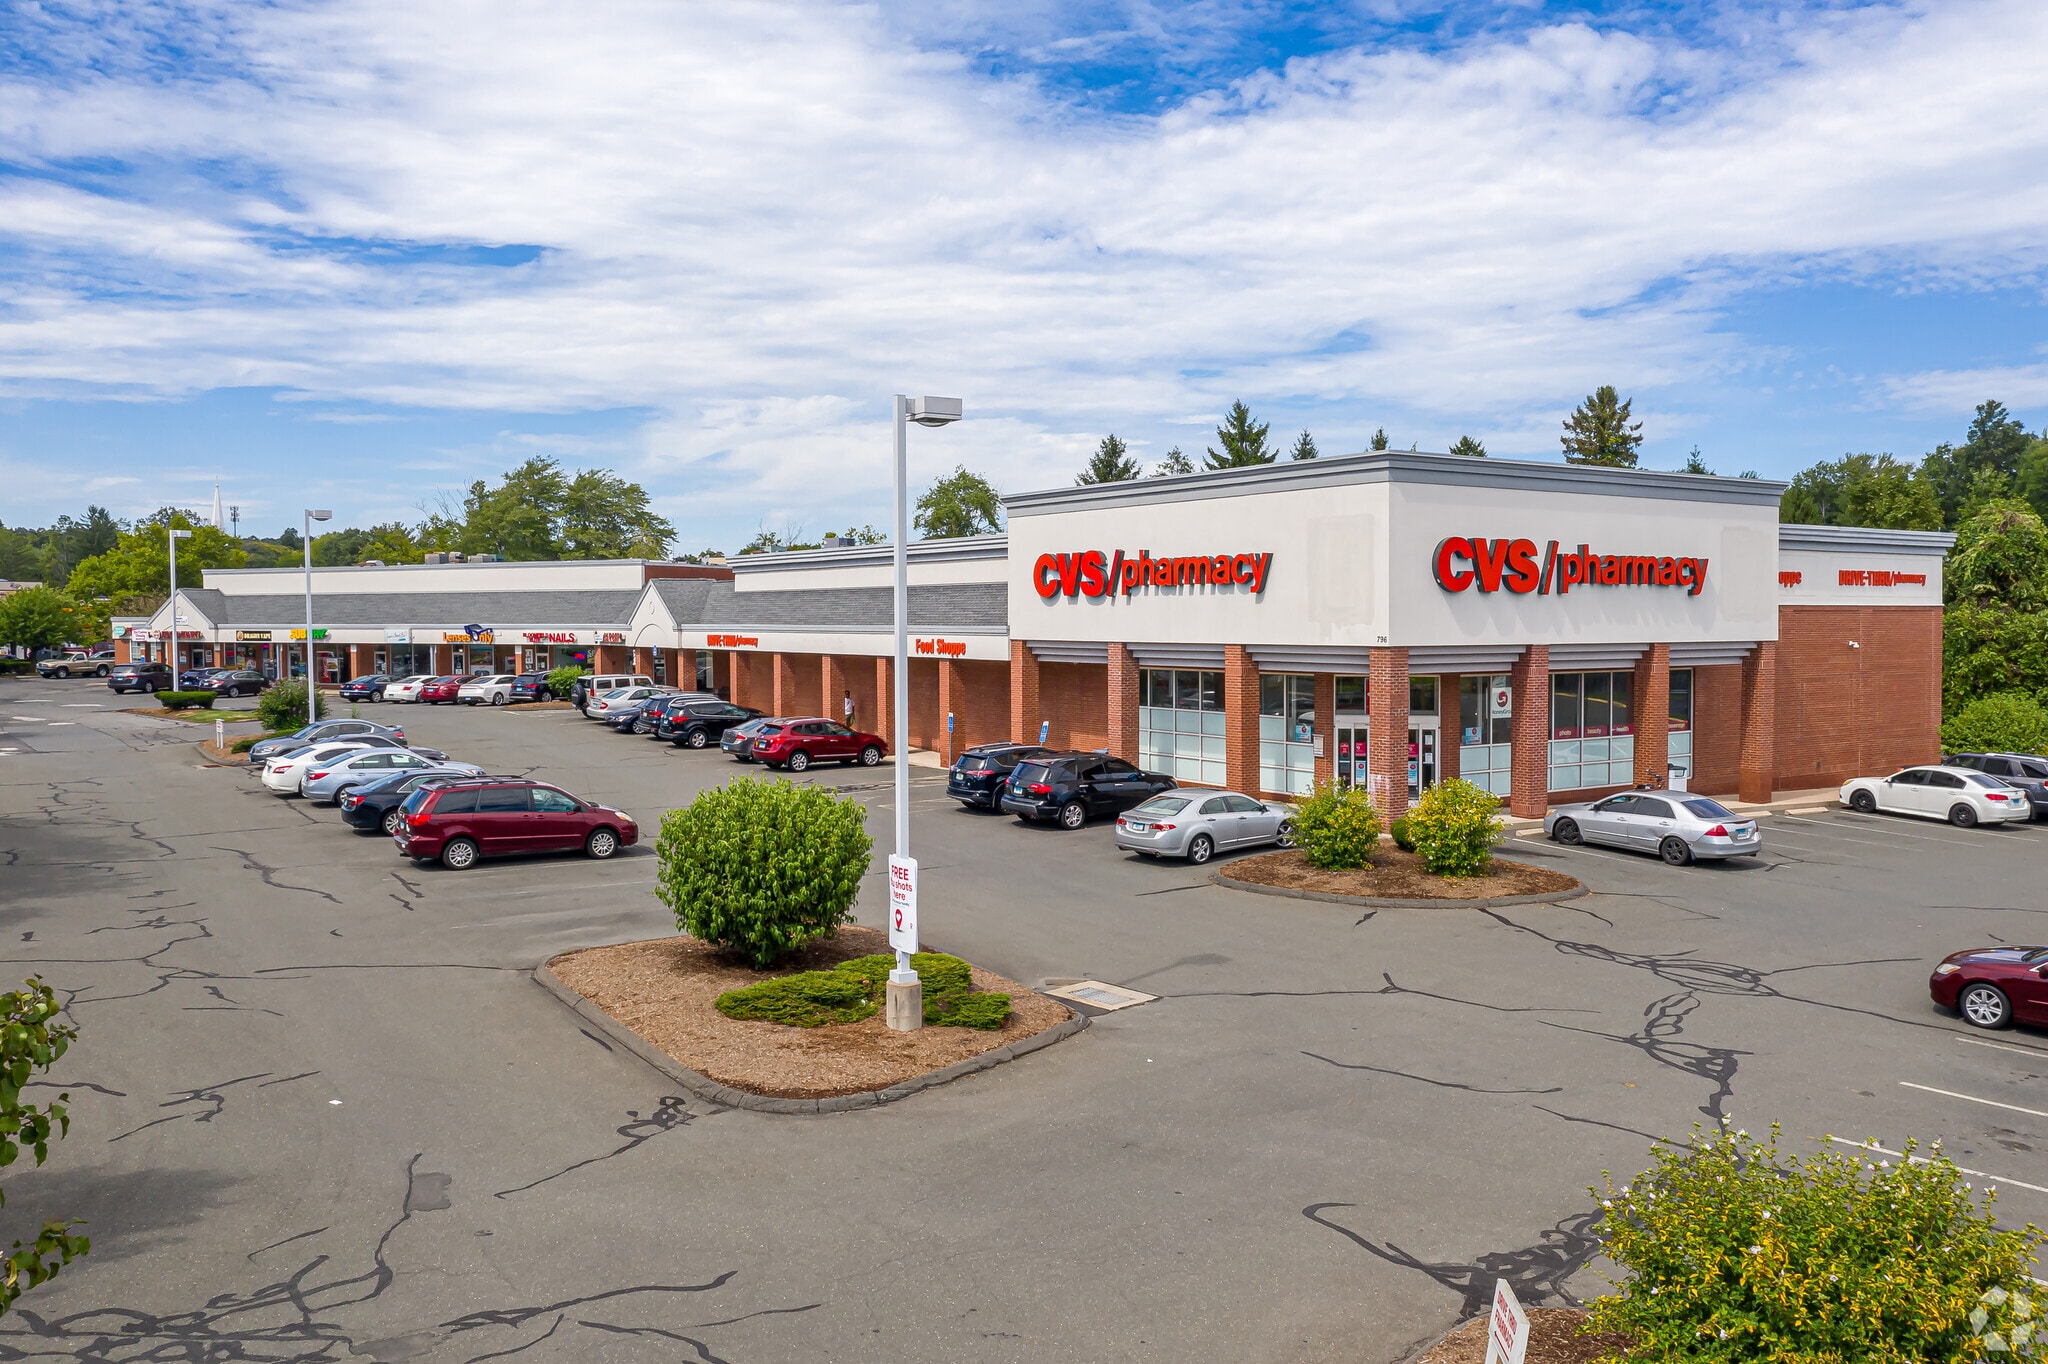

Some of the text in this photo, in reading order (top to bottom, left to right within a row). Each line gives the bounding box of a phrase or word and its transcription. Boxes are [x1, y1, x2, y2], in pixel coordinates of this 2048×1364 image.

[1033, 549, 1274, 598] CVS/pharmacy
[1432, 536, 1709, 596] CVS/pharmacy
[1778, 571, 1802, 588] oppe
[289, 628, 329, 640] SUBAY
[443, 631, 471, 643] Lenses
[549, 632, 576, 643] NAILS
[1376, 635, 1388, 644] 796
[915, 638, 967, 658] Food Shoppe
[891, 864, 910, 881] FREE
[895, 880, 913, 893] shots
